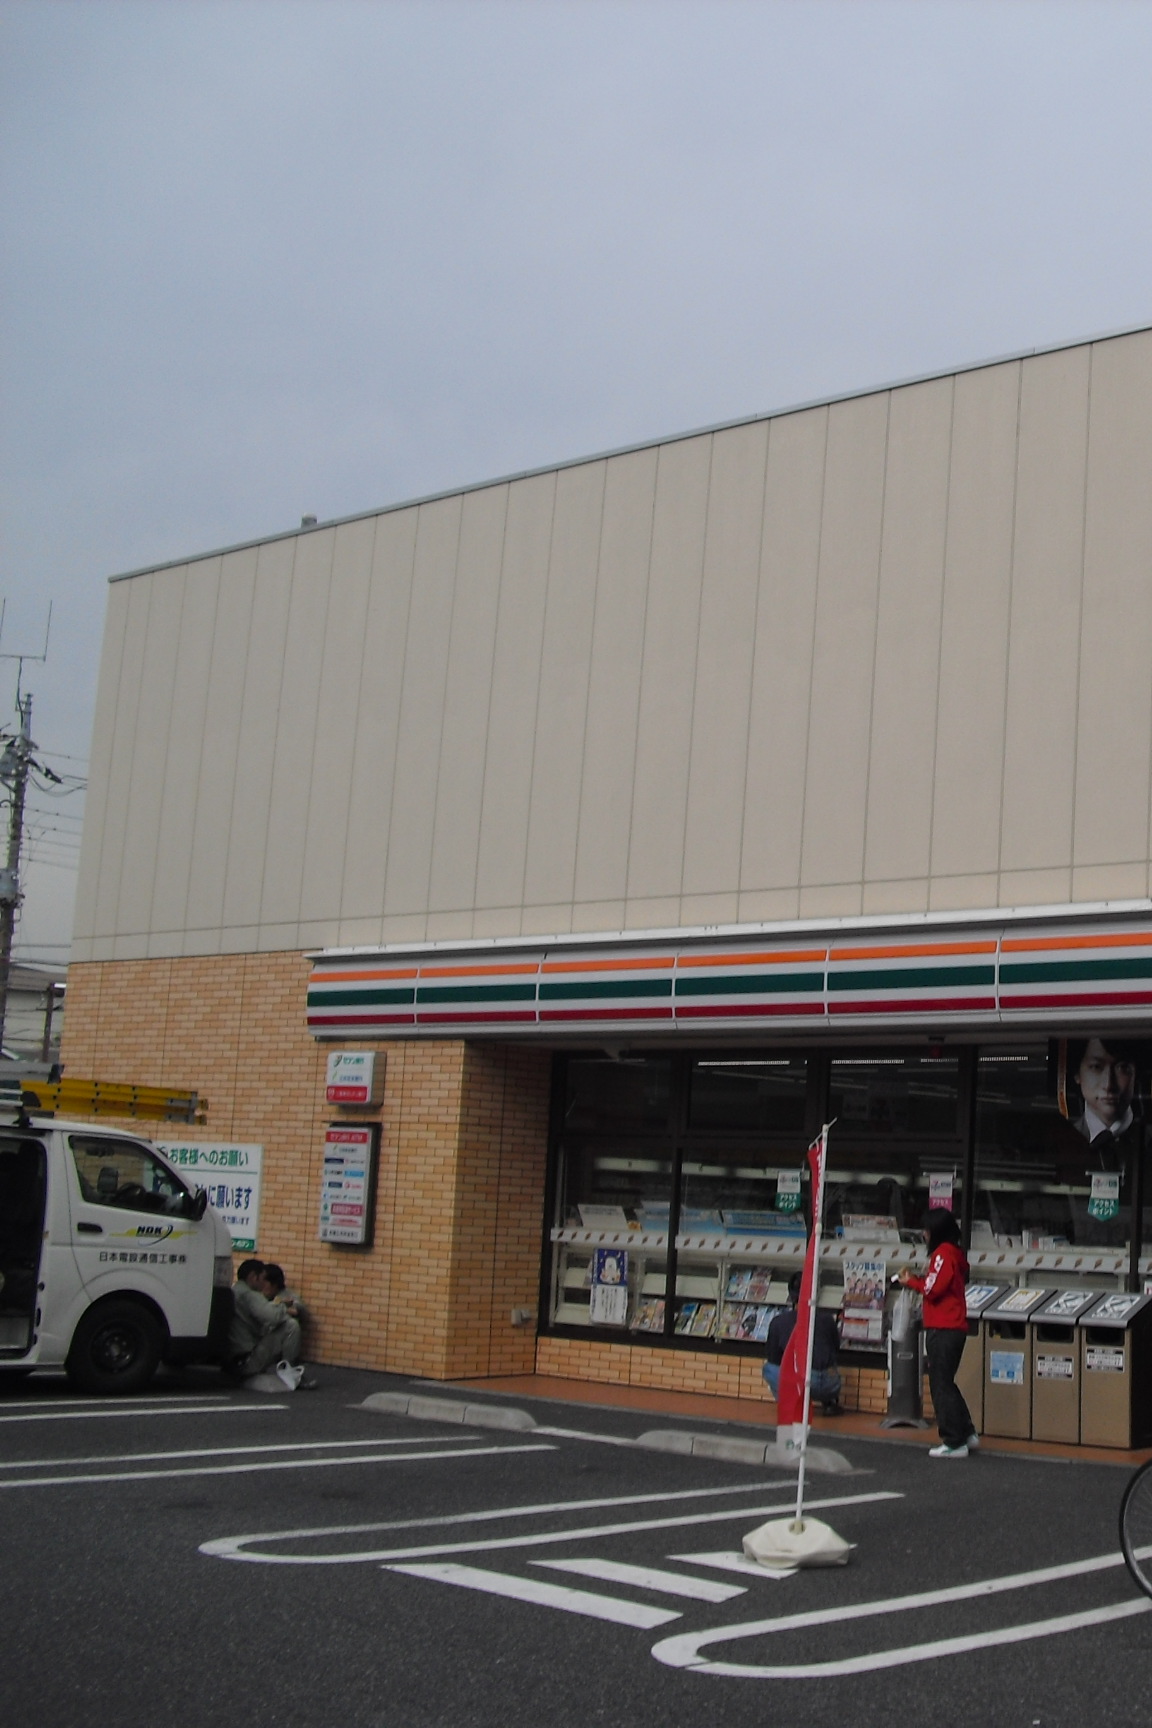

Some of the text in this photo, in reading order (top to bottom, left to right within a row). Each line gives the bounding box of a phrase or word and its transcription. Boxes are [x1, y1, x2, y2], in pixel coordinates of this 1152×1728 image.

[168, 1148, 249, 1167] お客様へのお願い
[205, 1185, 252, 1210] に願います
